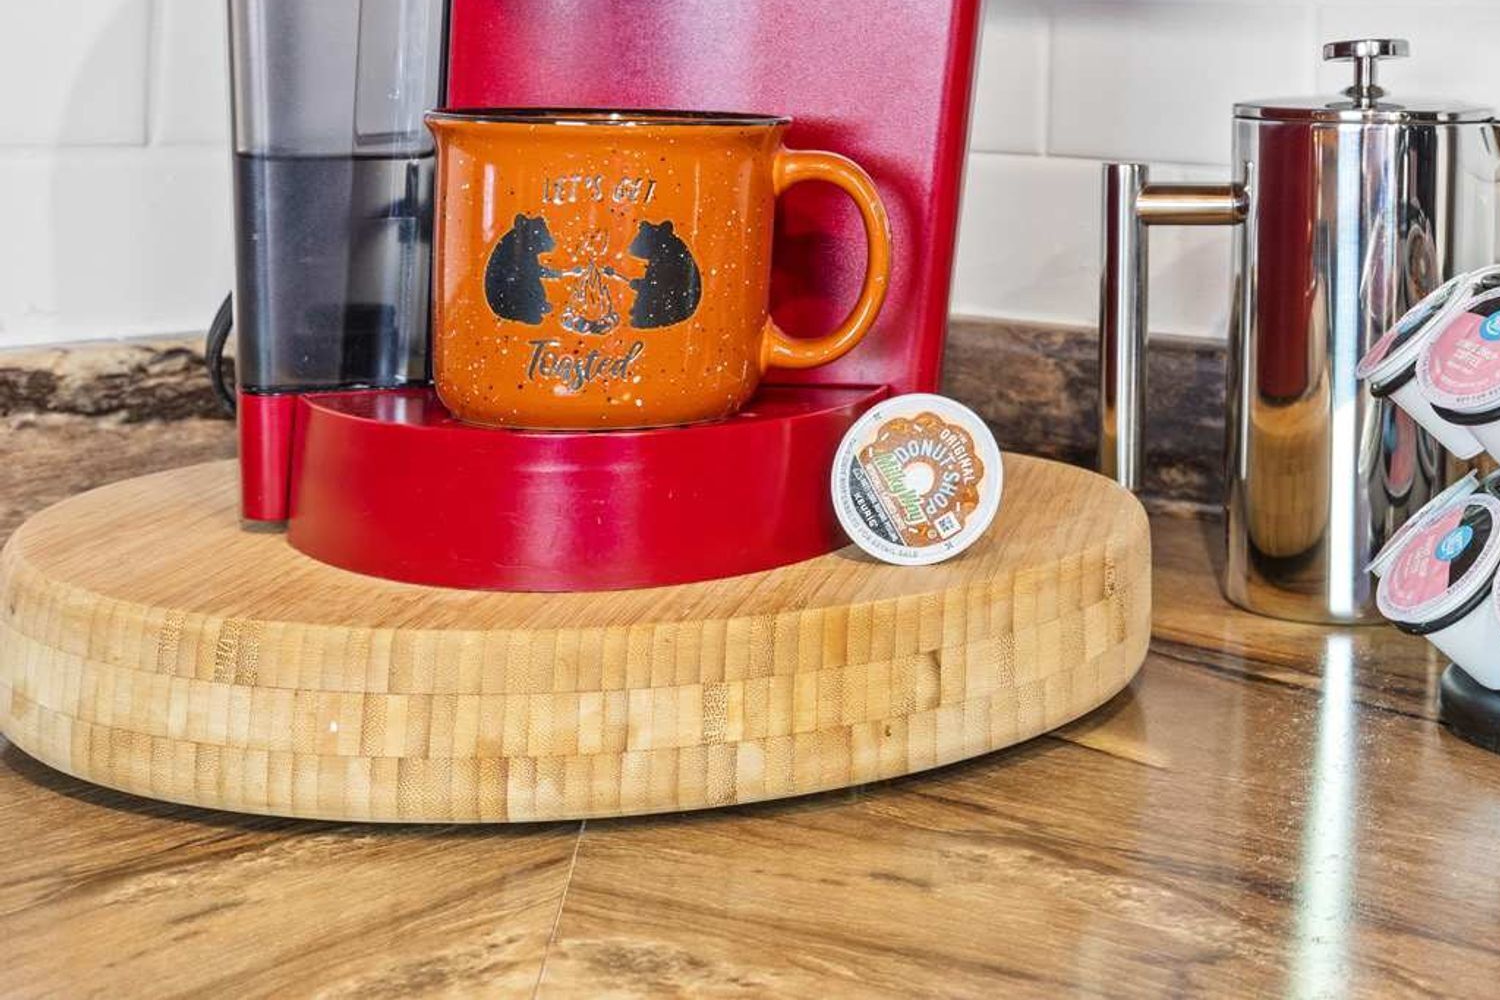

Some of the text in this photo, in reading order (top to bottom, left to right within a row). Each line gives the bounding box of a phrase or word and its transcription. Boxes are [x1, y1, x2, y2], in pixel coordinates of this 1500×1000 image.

[542, 174, 604, 205] LET'S
[528, 339, 645, 391] Toasted
[940, 428, 975, 485] ORIGINAL
[853, 491, 880, 529] KEURIG
